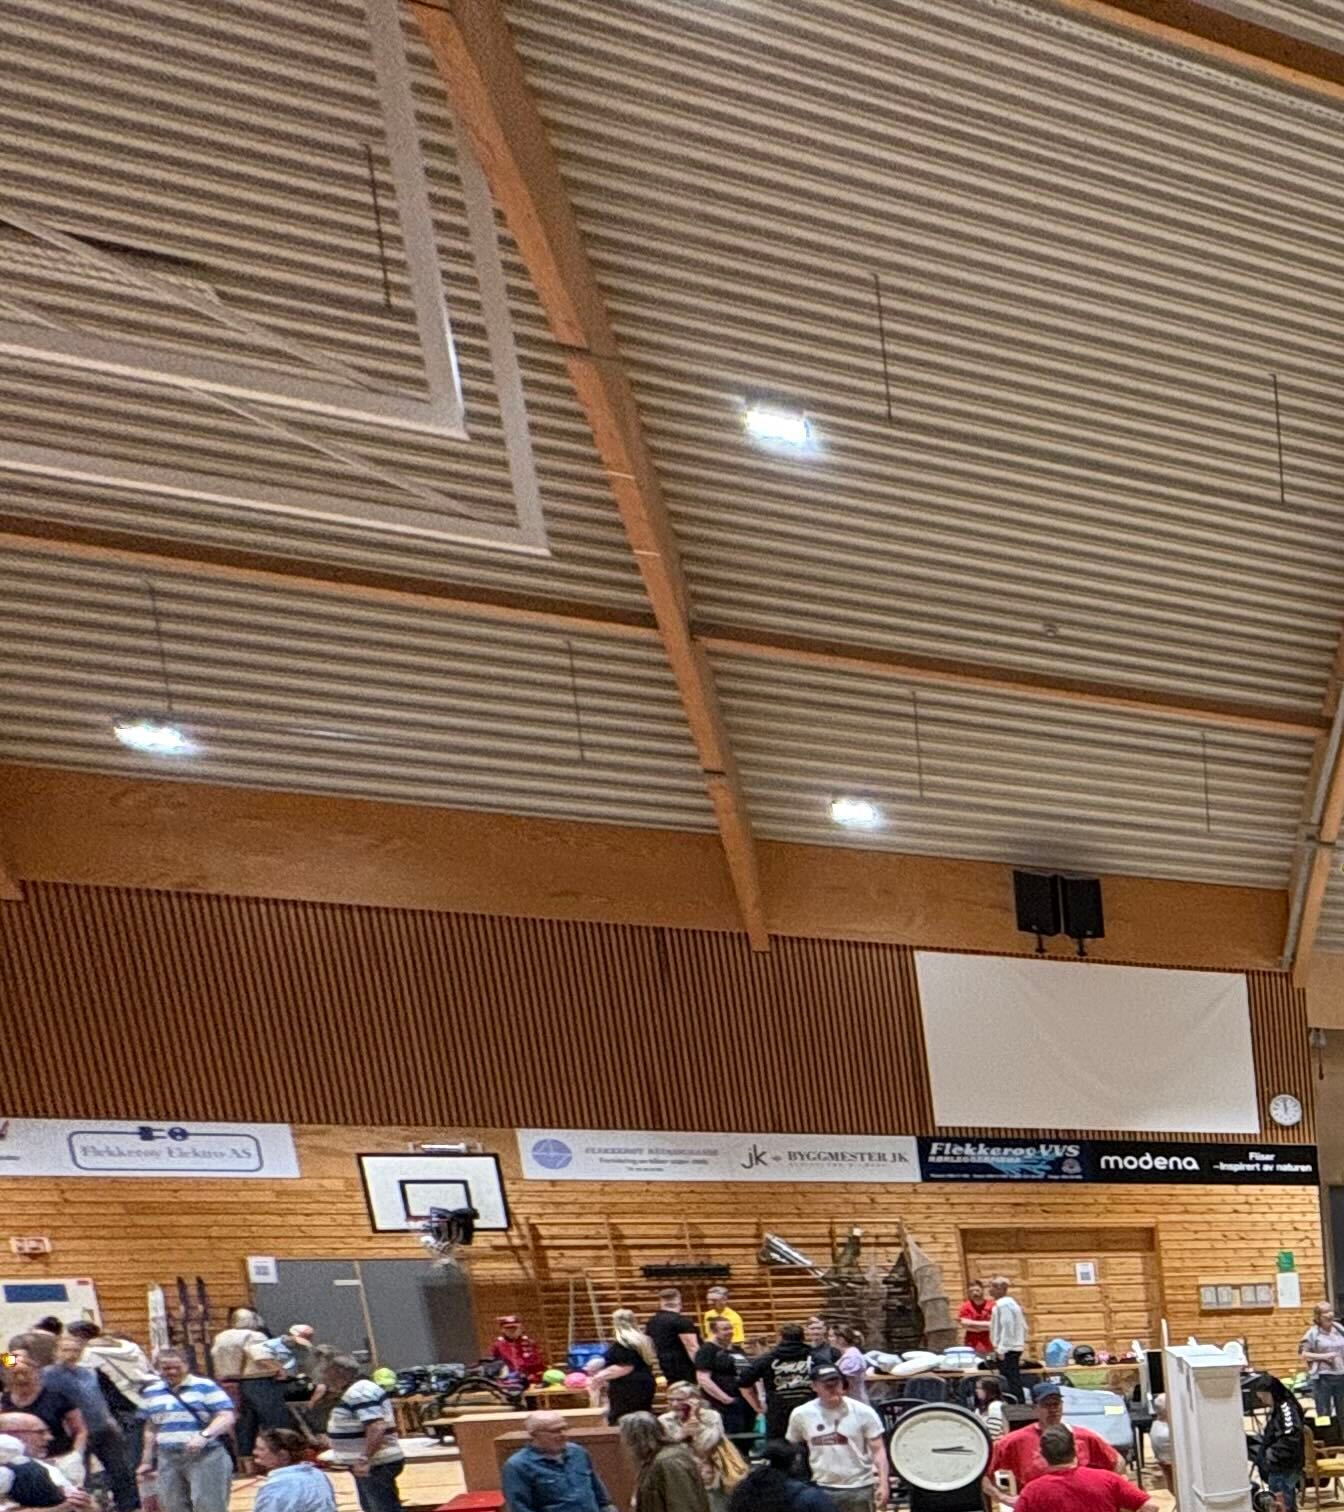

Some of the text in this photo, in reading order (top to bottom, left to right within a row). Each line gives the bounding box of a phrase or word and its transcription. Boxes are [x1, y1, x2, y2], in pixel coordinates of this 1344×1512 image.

[229, 1148, 252, 1159] AS
[1038, 1144, 1080, 1158] VVS
[1249, 1152, 1276, 1161] Fliser
[787, 1151, 909, 1164] BYGGMESTER JK
[1100, 1152, 1200, 1171] modena
[1263, 1163, 1275, 1171] av
[1276, 1163, 1313, 1172] naturen
